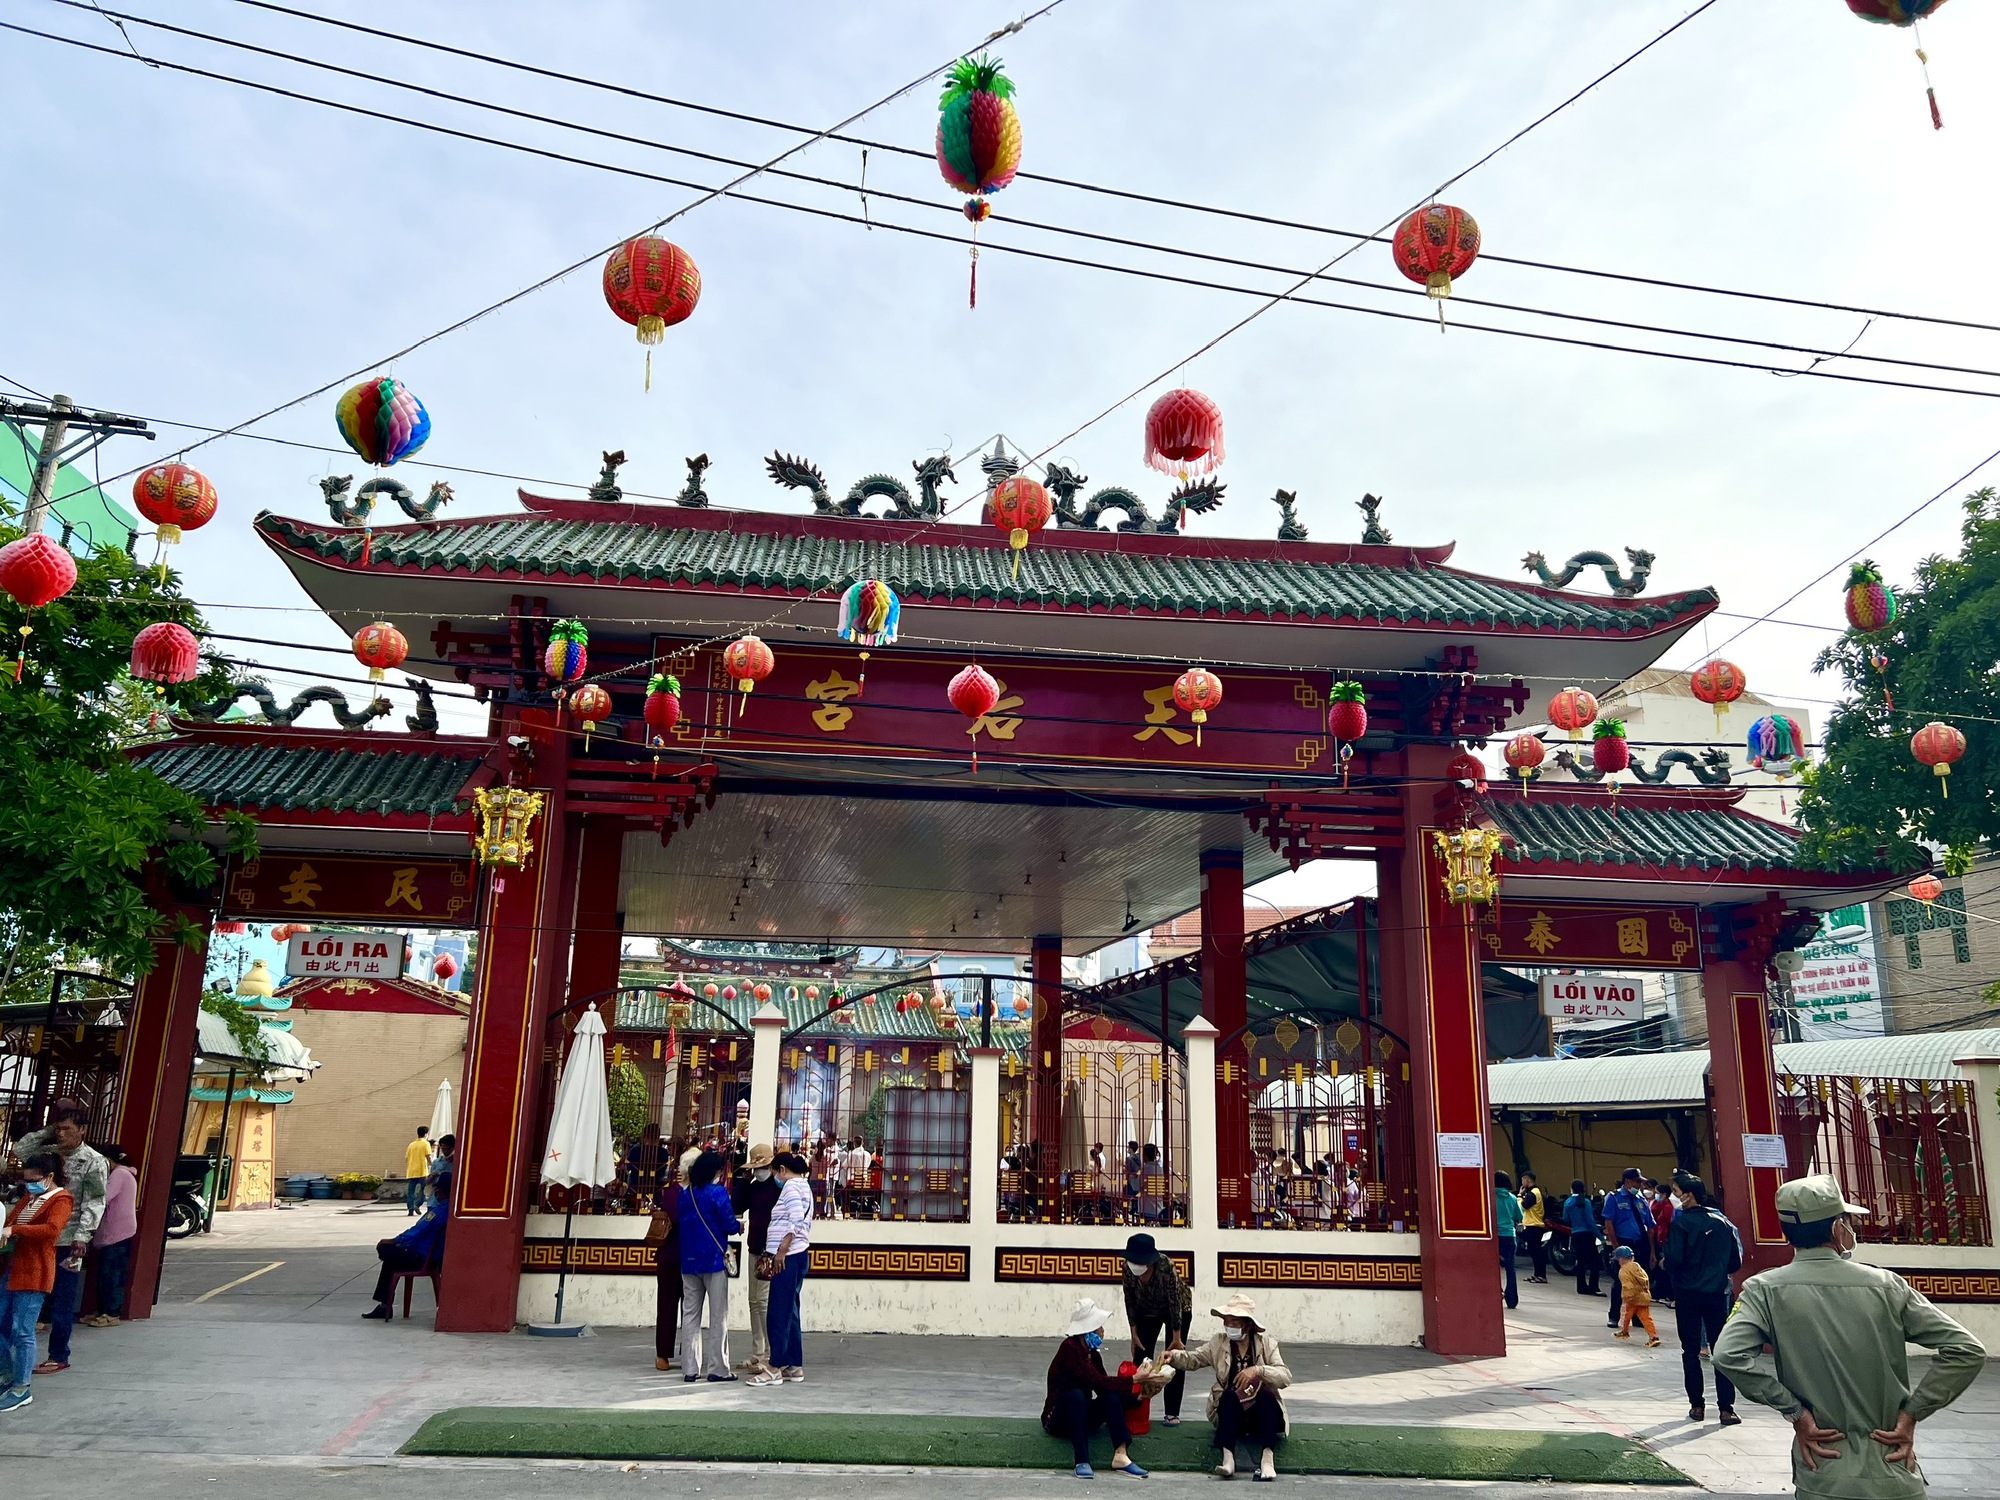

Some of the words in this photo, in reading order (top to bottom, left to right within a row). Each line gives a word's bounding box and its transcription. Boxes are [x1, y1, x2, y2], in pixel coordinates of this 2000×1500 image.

[301, 935, 344, 958] LỐI
[352, 941, 388, 958] RA
[305, 959, 380, 973] 由此門出
[1553, 980, 1586, 1001] LỐI
[1593, 984, 1635, 1002] VÀO
[1563, 1003, 1626, 1017] 由此門入
